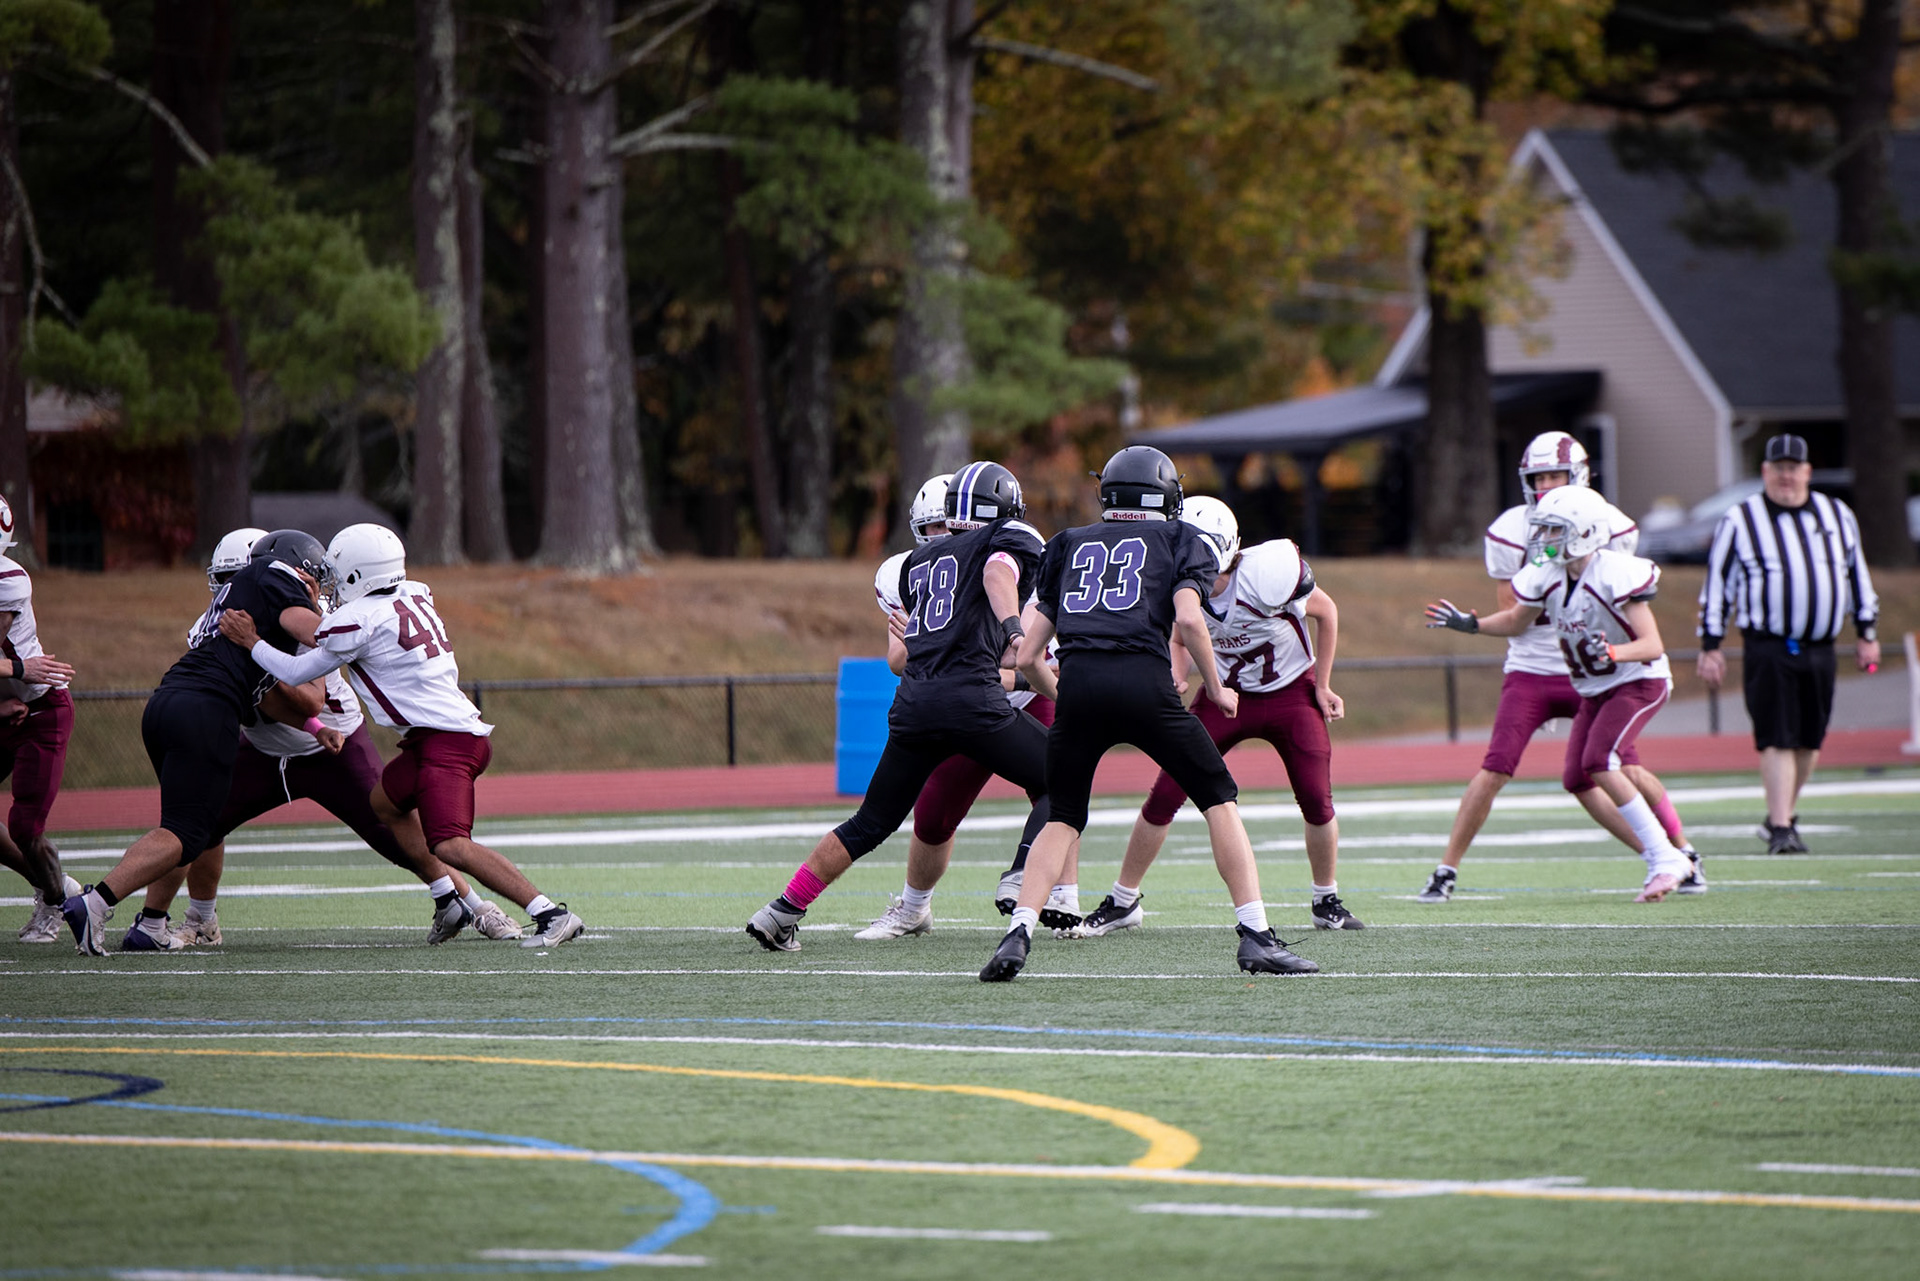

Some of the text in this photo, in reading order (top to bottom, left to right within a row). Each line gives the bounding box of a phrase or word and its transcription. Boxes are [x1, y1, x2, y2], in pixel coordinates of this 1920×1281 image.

[950, 520, 980, 530] Riddell
[1112, 512, 1147, 520] Riddell
[903, 555, 959, 638] 78
[1063, 537, 1147, 613] 33
[393, 594, 454, 659] 40
[1217, 633, 1251, 649] RAMS
[1216, 641, 1280, 691] 77
